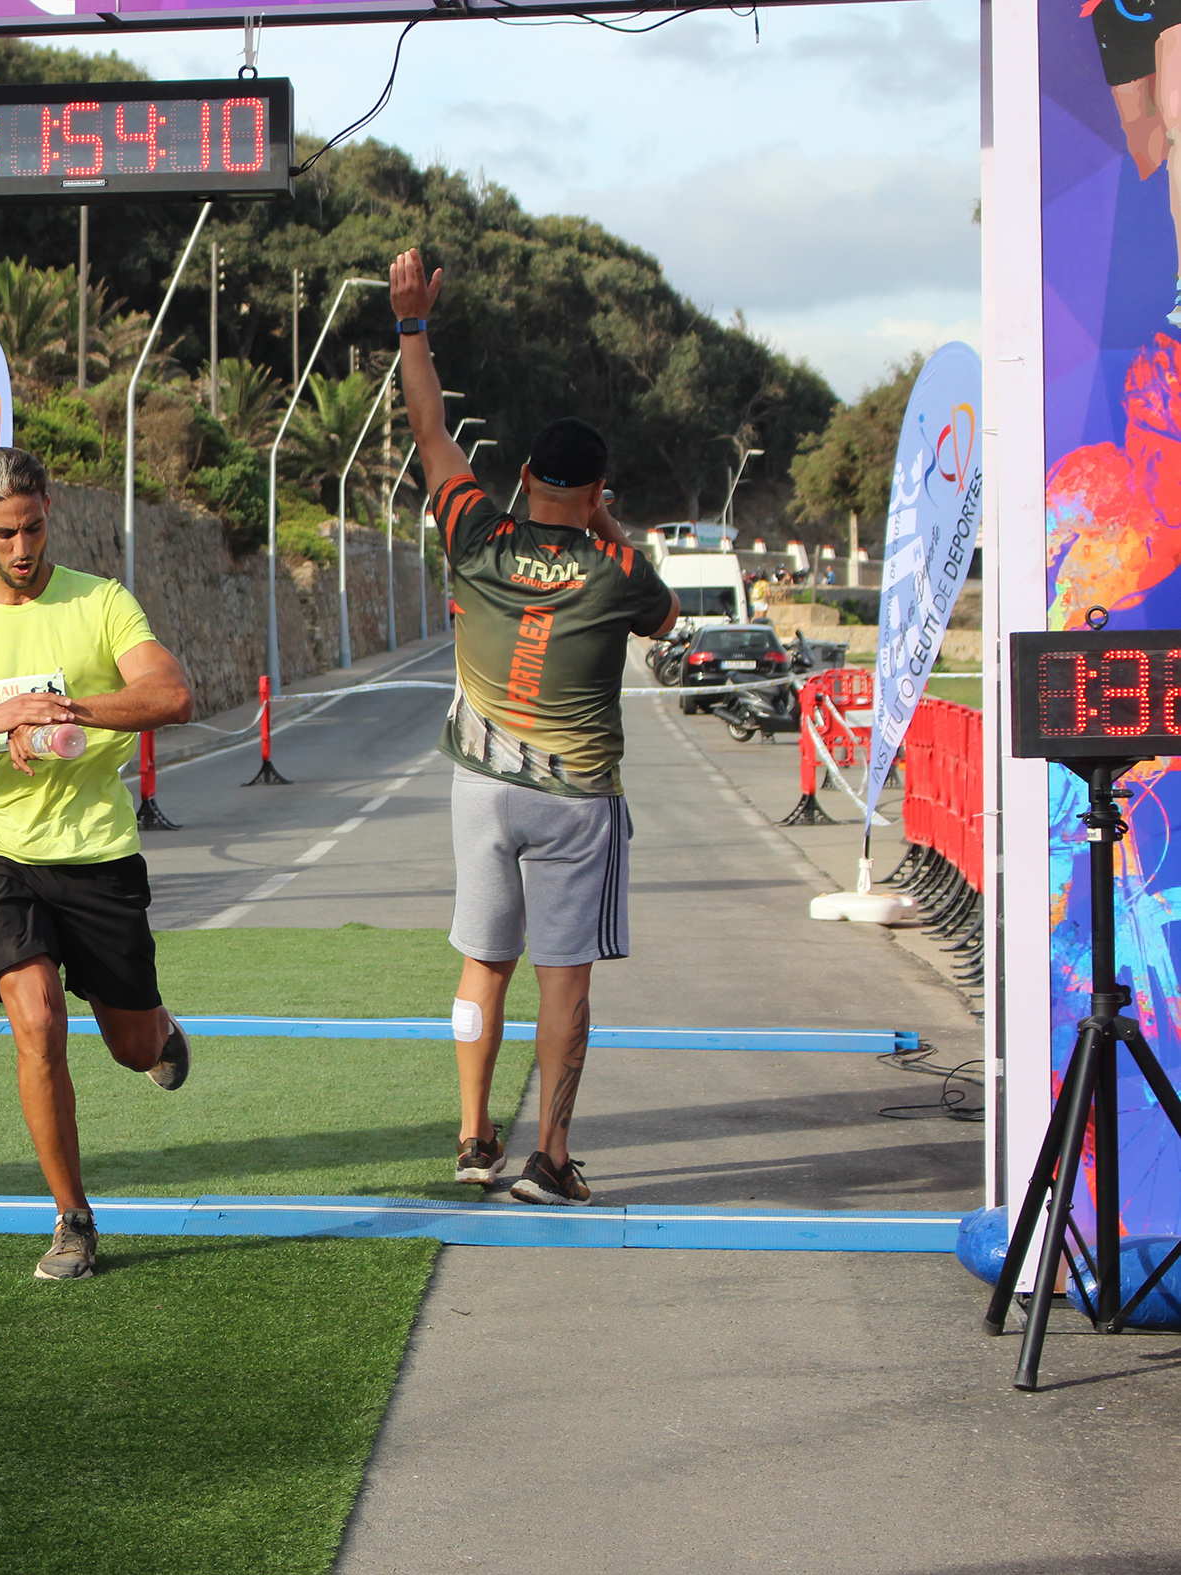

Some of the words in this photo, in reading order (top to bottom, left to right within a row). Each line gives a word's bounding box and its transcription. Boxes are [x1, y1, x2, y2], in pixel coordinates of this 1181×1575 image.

[892, 509, 902, 555] CEUTA
[511, 573, 584, 590] CANICROSS
[514, 555, 587, 583] TRAIL
[889, 560, 897, 579] DE
[872, 679, 916, 785] INSTITUTO
[933, 579, 953, 614] DE
[943, 467, 982, 582] DEPORTES
[507, 605, 556, 707] FORTALEZA
[877, 676, 886, 733] CIUDAD
